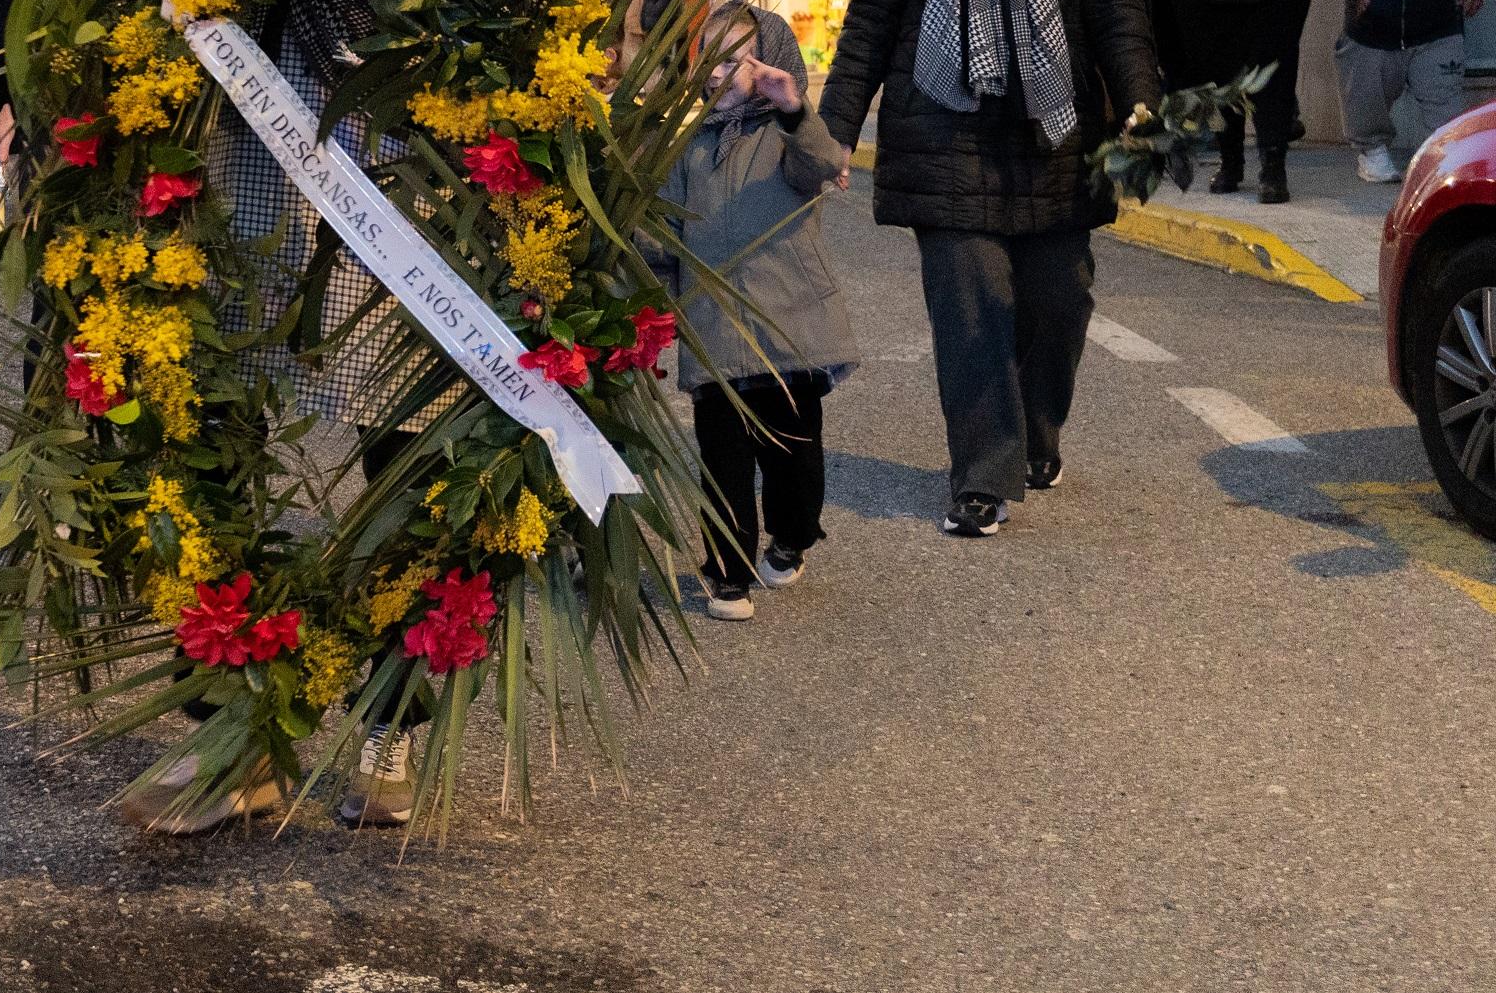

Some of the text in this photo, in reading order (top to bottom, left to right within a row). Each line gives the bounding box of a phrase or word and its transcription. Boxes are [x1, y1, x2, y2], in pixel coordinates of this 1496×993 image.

[204, 28, 536, 403] POR FÍN DESCANSAS... E NÓS TAMÉN
